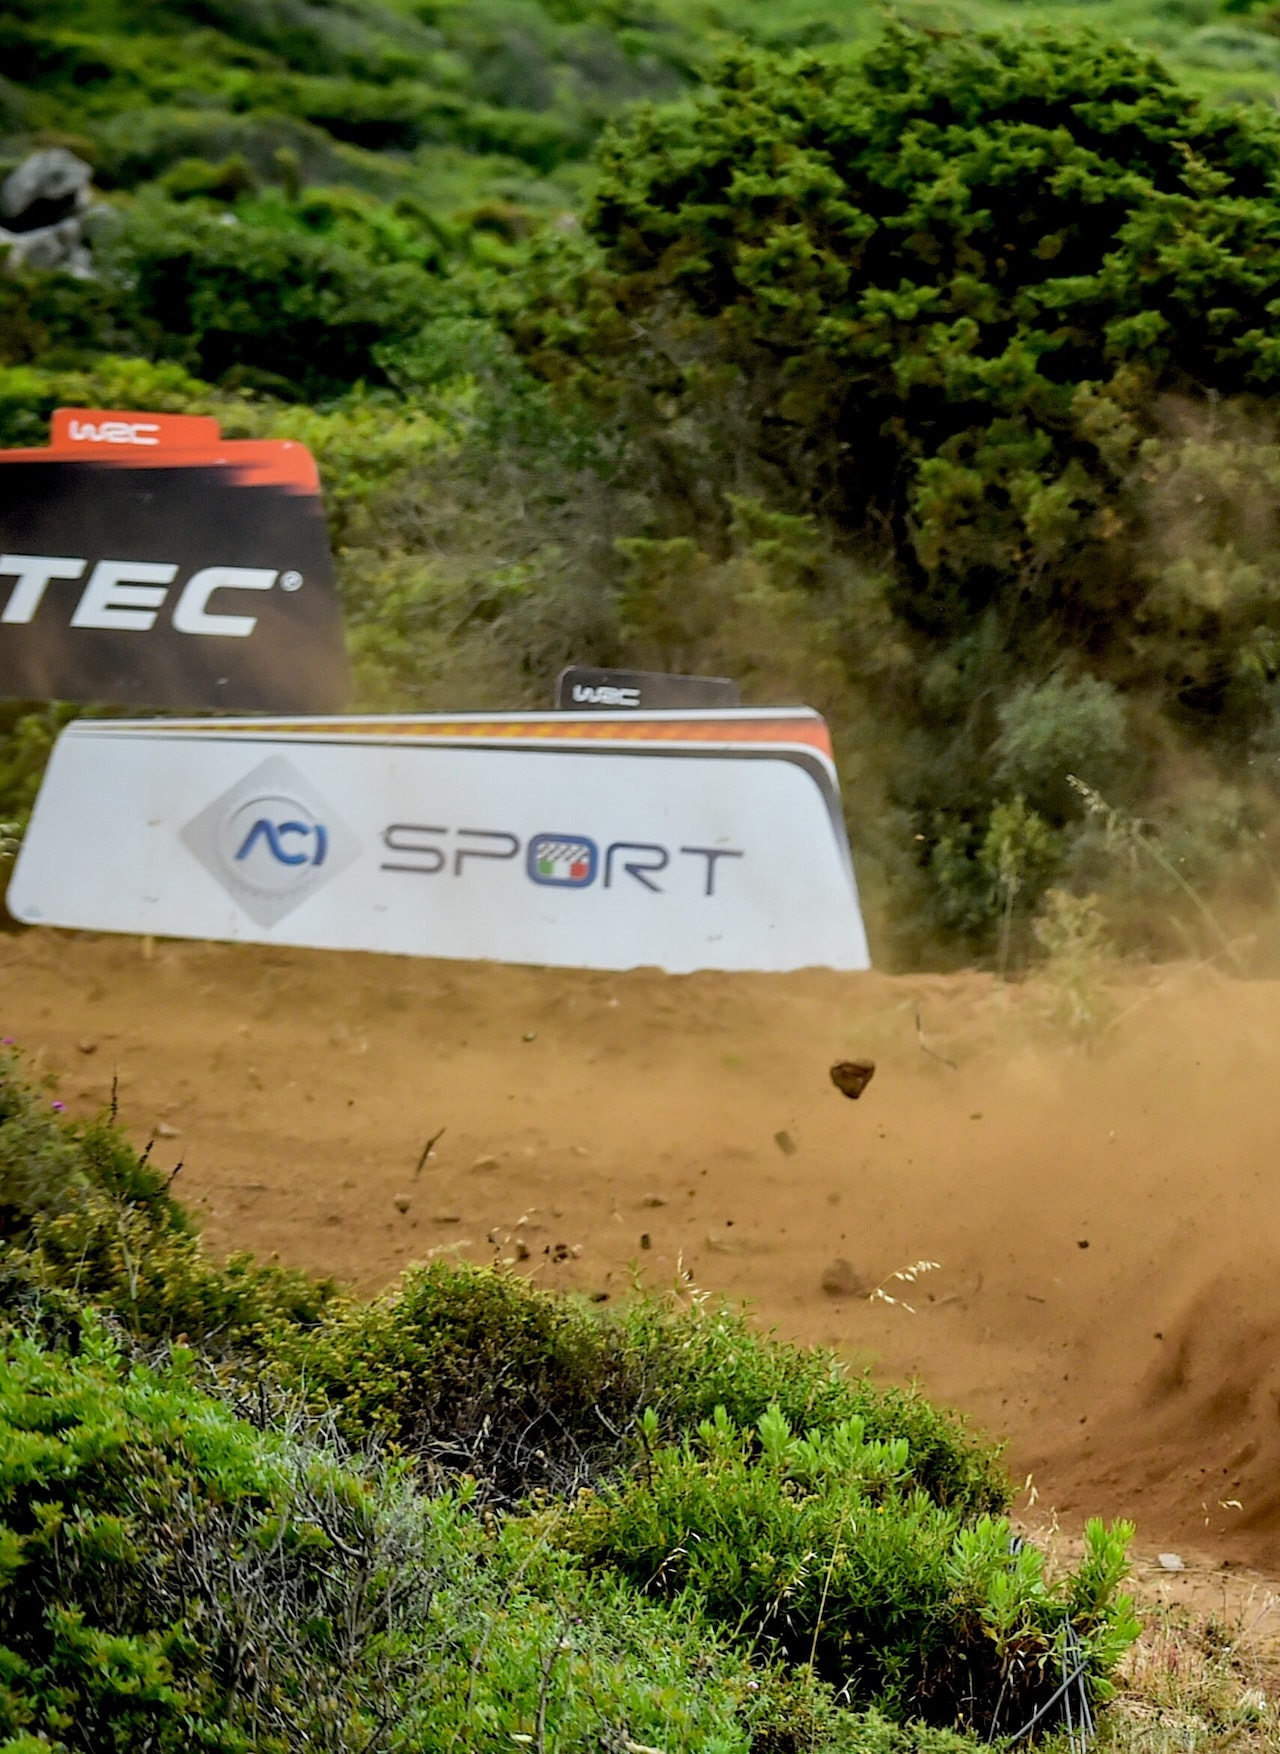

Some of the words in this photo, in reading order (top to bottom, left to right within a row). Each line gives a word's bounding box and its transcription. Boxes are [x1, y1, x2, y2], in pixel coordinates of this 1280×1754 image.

[68, 419, 161, 446] WRC
[572, 684, 641, 707] WRC
[234, 818, 329, 866] ACI
[380, 822, 744, 897] SPORT
